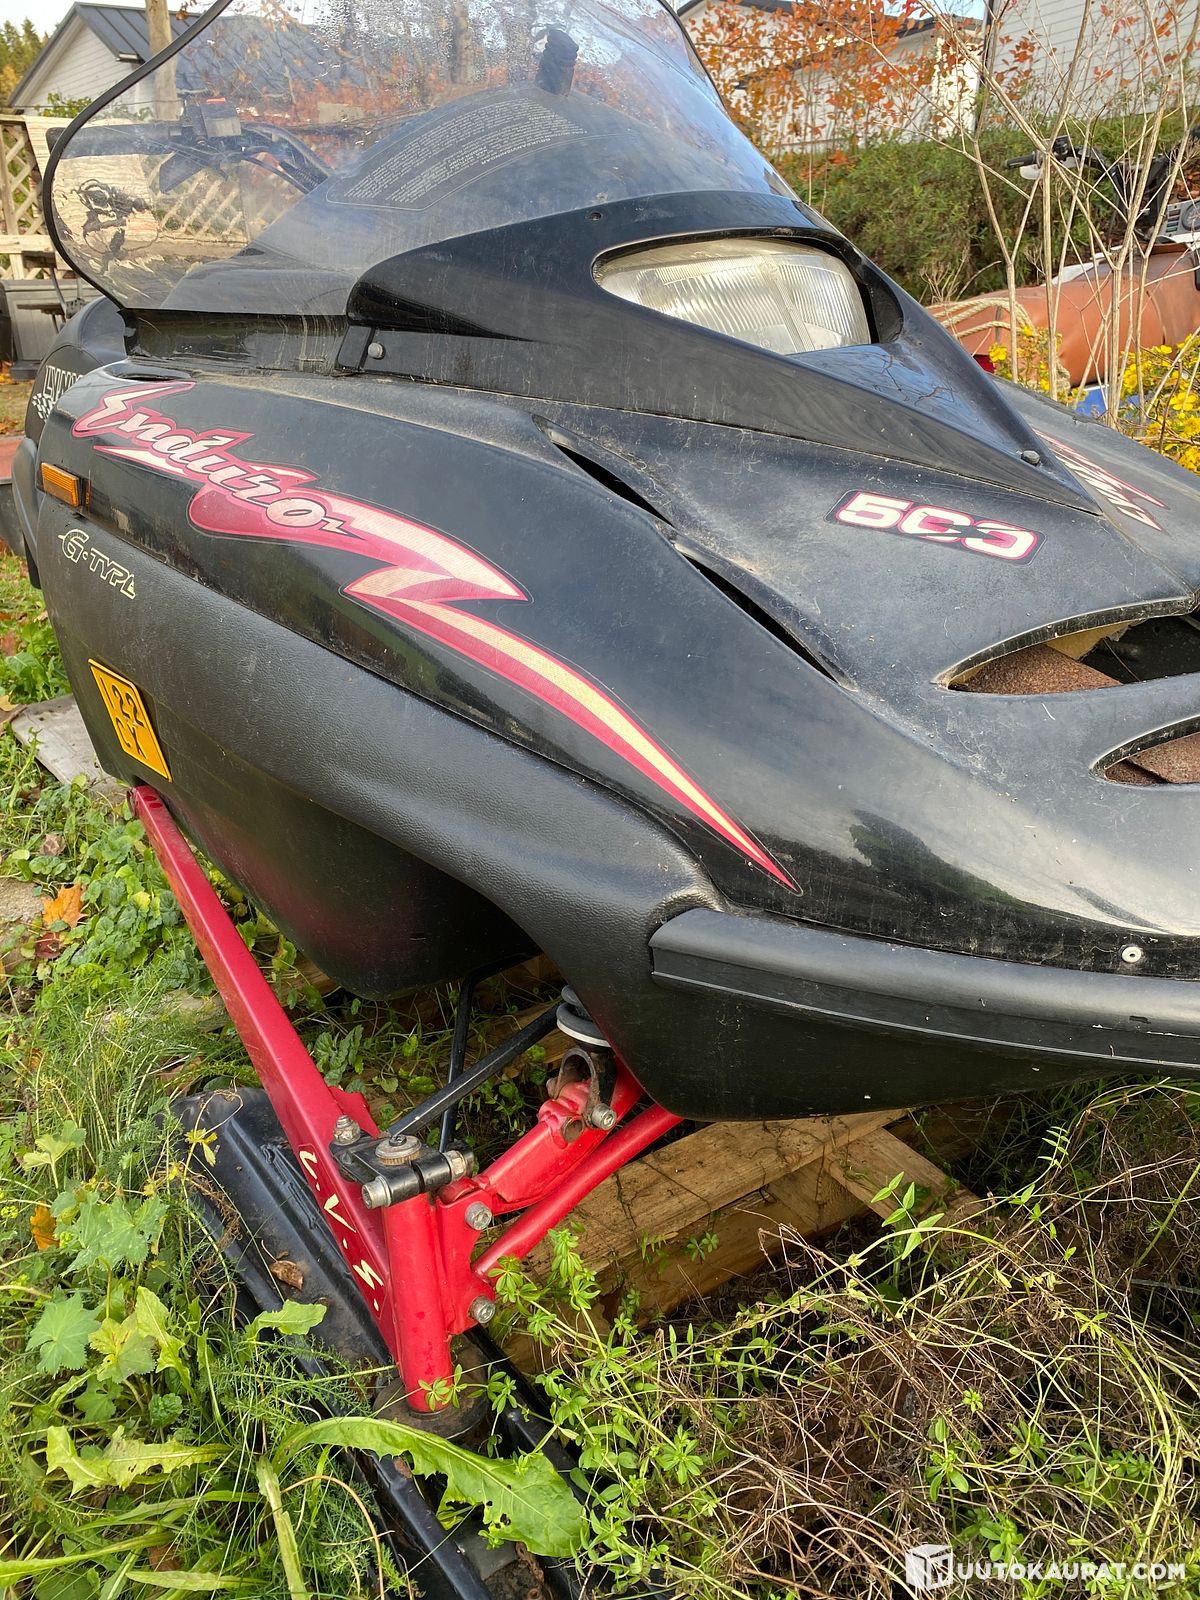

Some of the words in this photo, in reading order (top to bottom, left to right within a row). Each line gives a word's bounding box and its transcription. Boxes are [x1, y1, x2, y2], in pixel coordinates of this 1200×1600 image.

[43, 365, 84, 405] LYN
[74, 385, 352, 535] Enduro
[115, 717, 147, 759] CX
